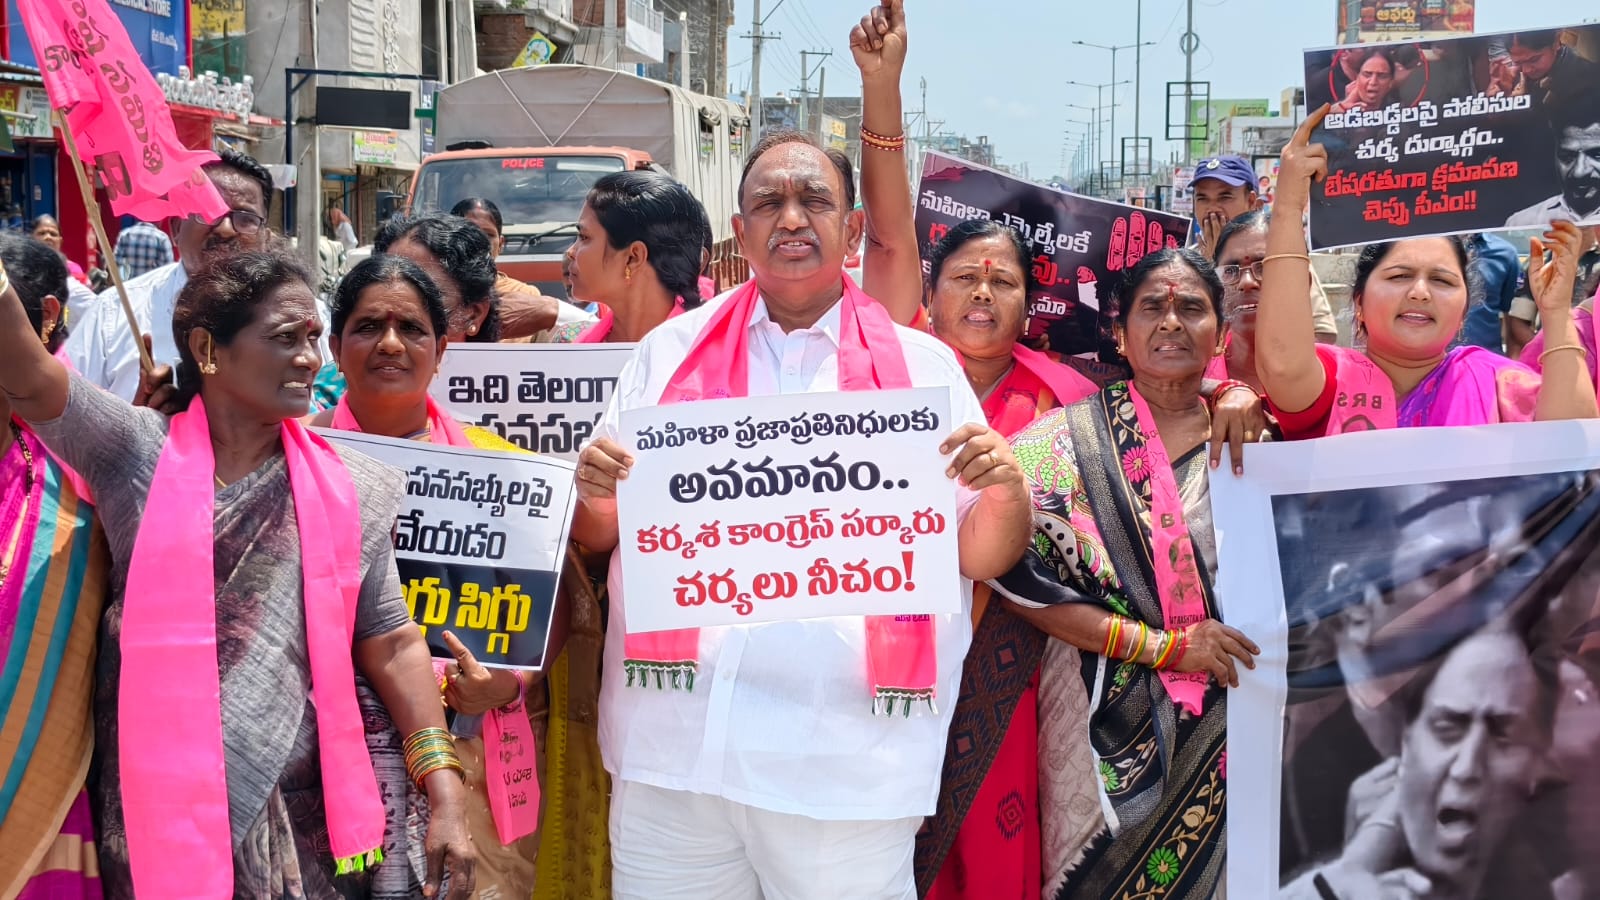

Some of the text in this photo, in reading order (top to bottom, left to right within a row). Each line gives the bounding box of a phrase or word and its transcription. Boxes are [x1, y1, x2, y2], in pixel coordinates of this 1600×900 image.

[147, 0, 171, 17] STORE
[1324, 91, 1531, 135] ఆడబిడ్డలపై పోలీసుల
[502, 158, 545, 169] POLICE
[1355, 127, 1504, 163] చర్య దుర్మార్గం..
[921, 189, 991, 221] మహిళా
[1324, 168, 1427, 198] బేషరతుగా
[1362, 190, 1477, 227] చెప్పు సీఎం!!
[448, 374, 510, 404] ఇది
[636, 406, 940, 451] మహిళా ప్రజాప్రతినిధులకు
[406, 465, 554, 519] సనసభ్యులపై
[669, 450, 910, 504] అవమానం..
[396, 509, 507, 559] వేయడం
[636, 507, 946, 559] కర్కశ కాంగ్రెస్ సర్కారు
[673, 550, 916, 616] చర్యలు నీచం!
[455, 582, 532, 655] సిగ్గు
